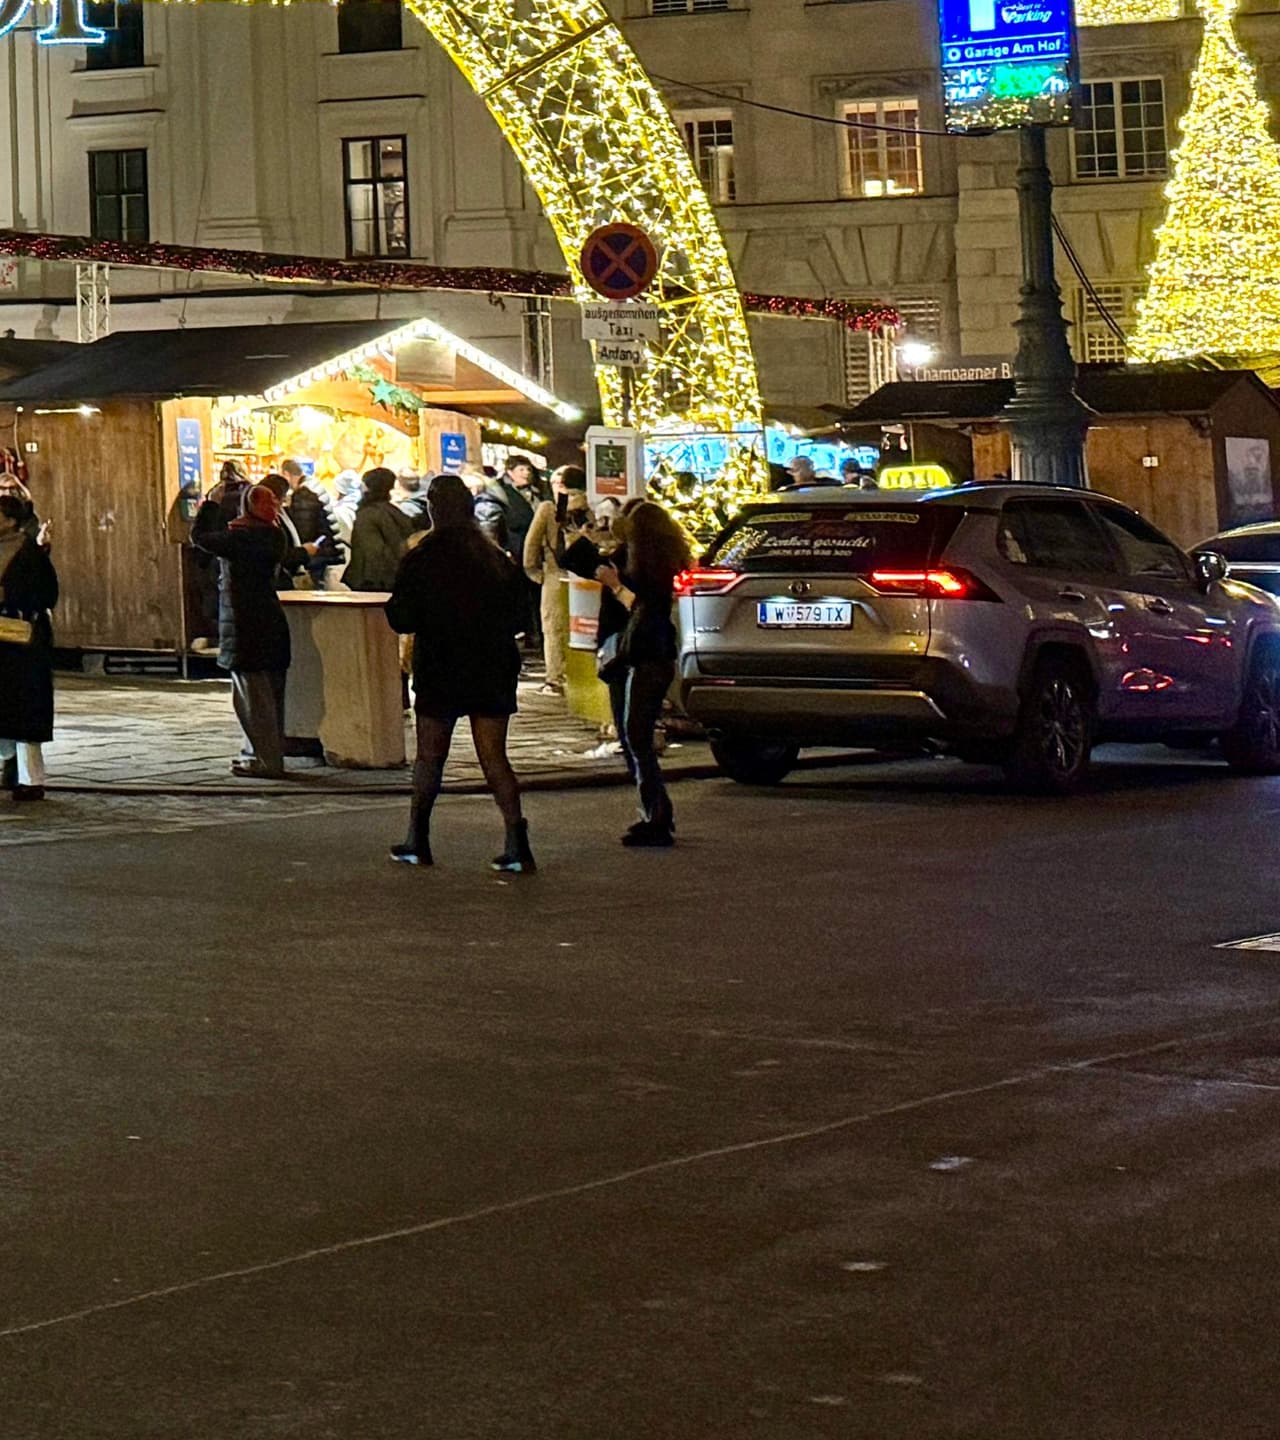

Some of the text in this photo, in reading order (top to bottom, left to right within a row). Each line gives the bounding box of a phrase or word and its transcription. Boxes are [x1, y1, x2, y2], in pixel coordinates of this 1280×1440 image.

[1004, 10, 1053, 24] Parking
[965, 38, 1061, 59] Garage Am Hof
[608, 323, 633, 336] Taxi
[600, 346, 640, 364] Anfang
[813, 536, 871, 549] gesucht
[775, 607, 843, 621] W 579 TX
